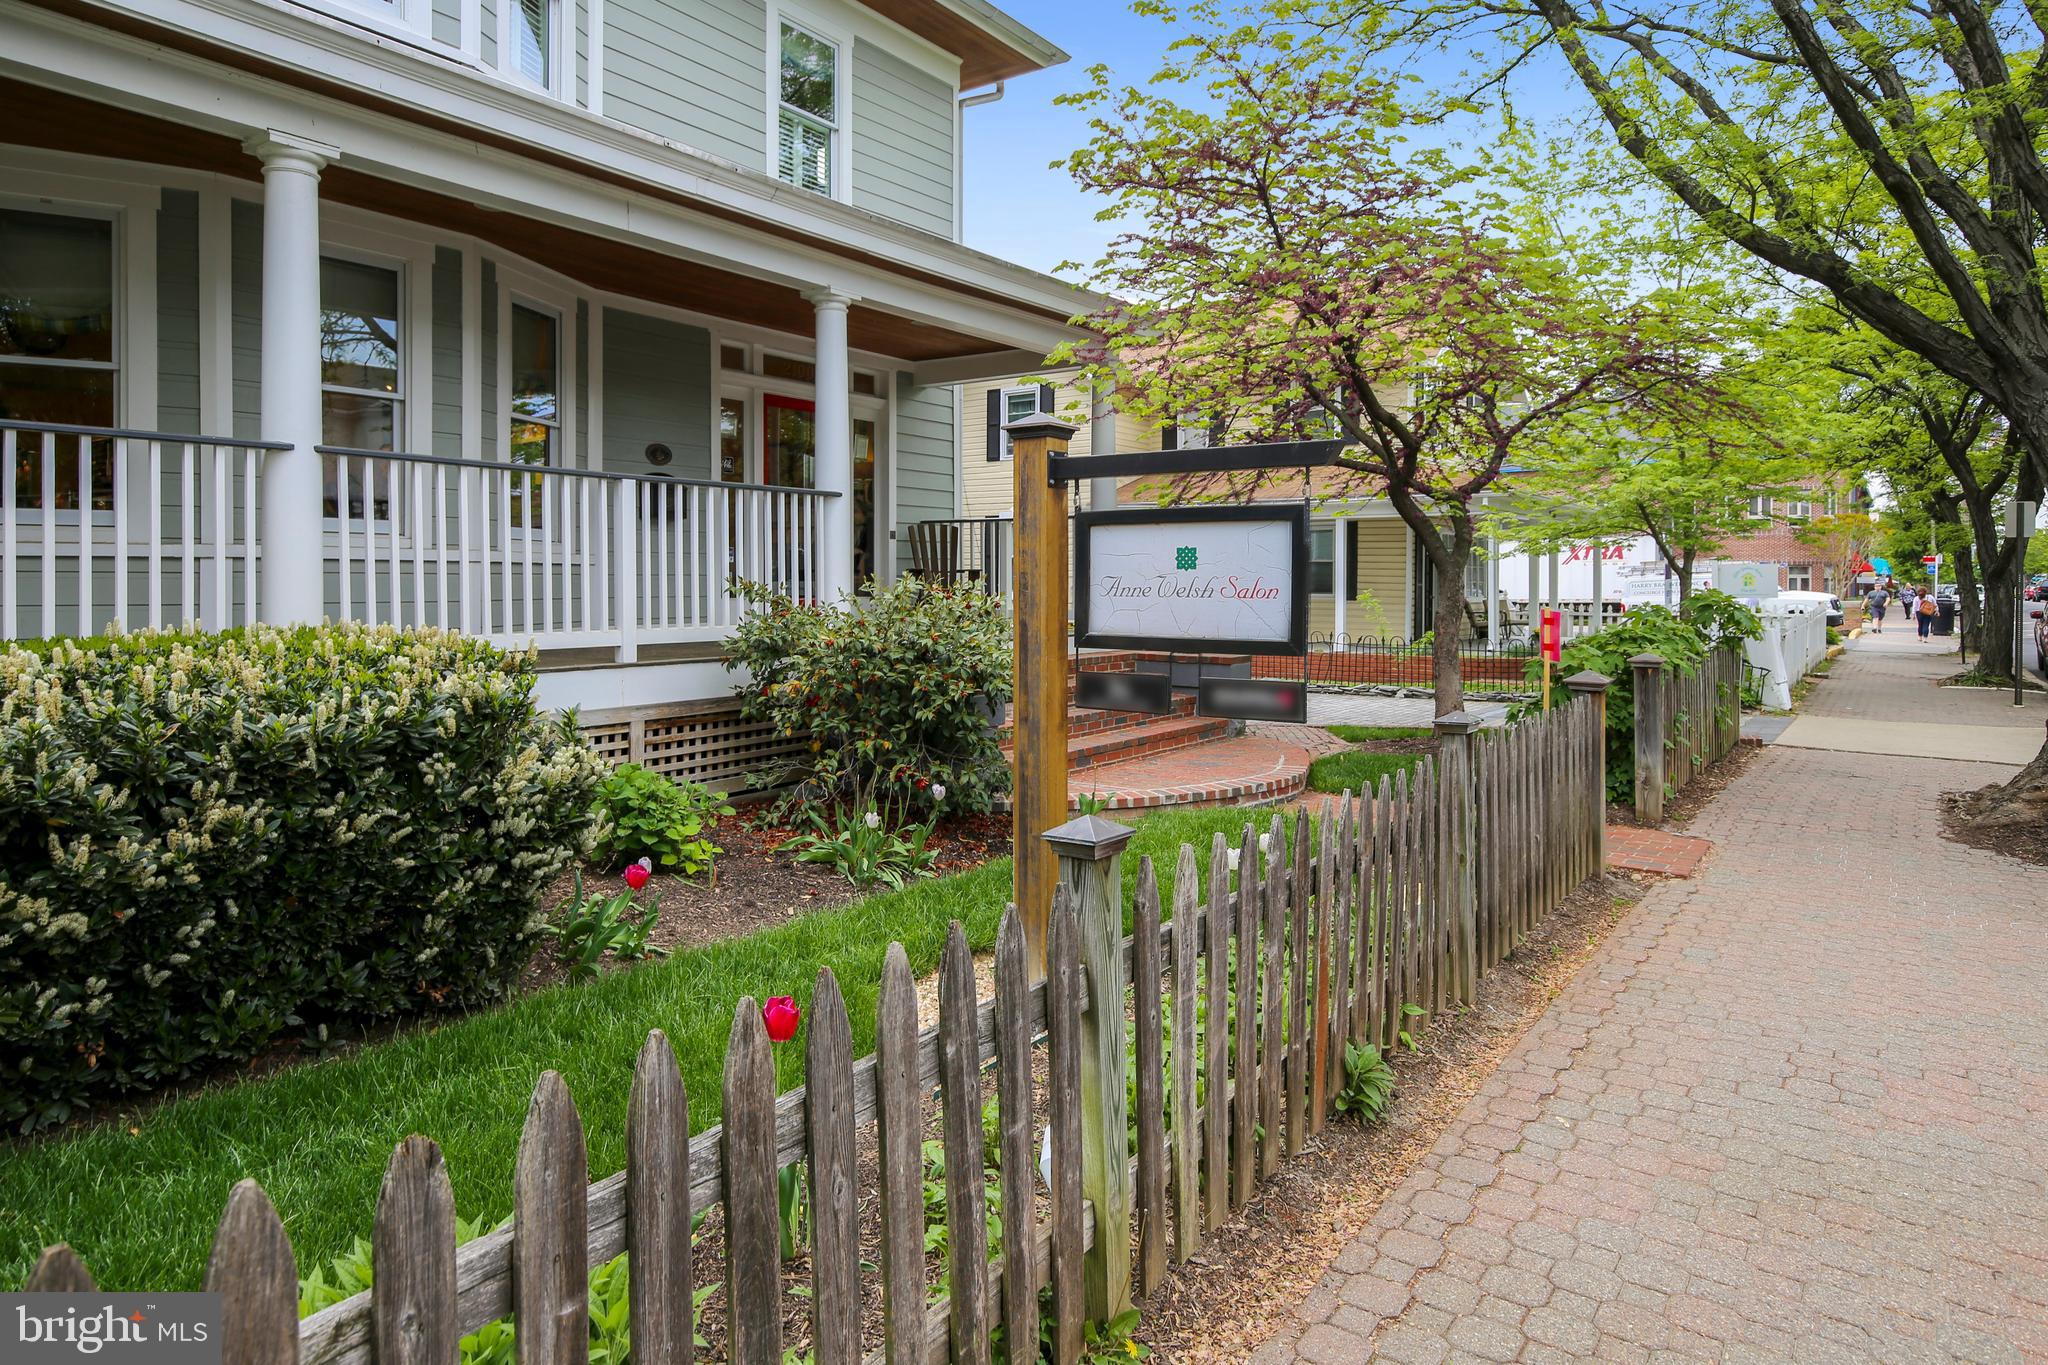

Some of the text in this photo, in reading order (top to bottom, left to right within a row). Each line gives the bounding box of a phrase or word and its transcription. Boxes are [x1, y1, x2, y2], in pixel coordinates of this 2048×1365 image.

[1562, 545, 1624, 565] XTRA
[1100, 575, 1279, 600] Anne Welsh Salon
